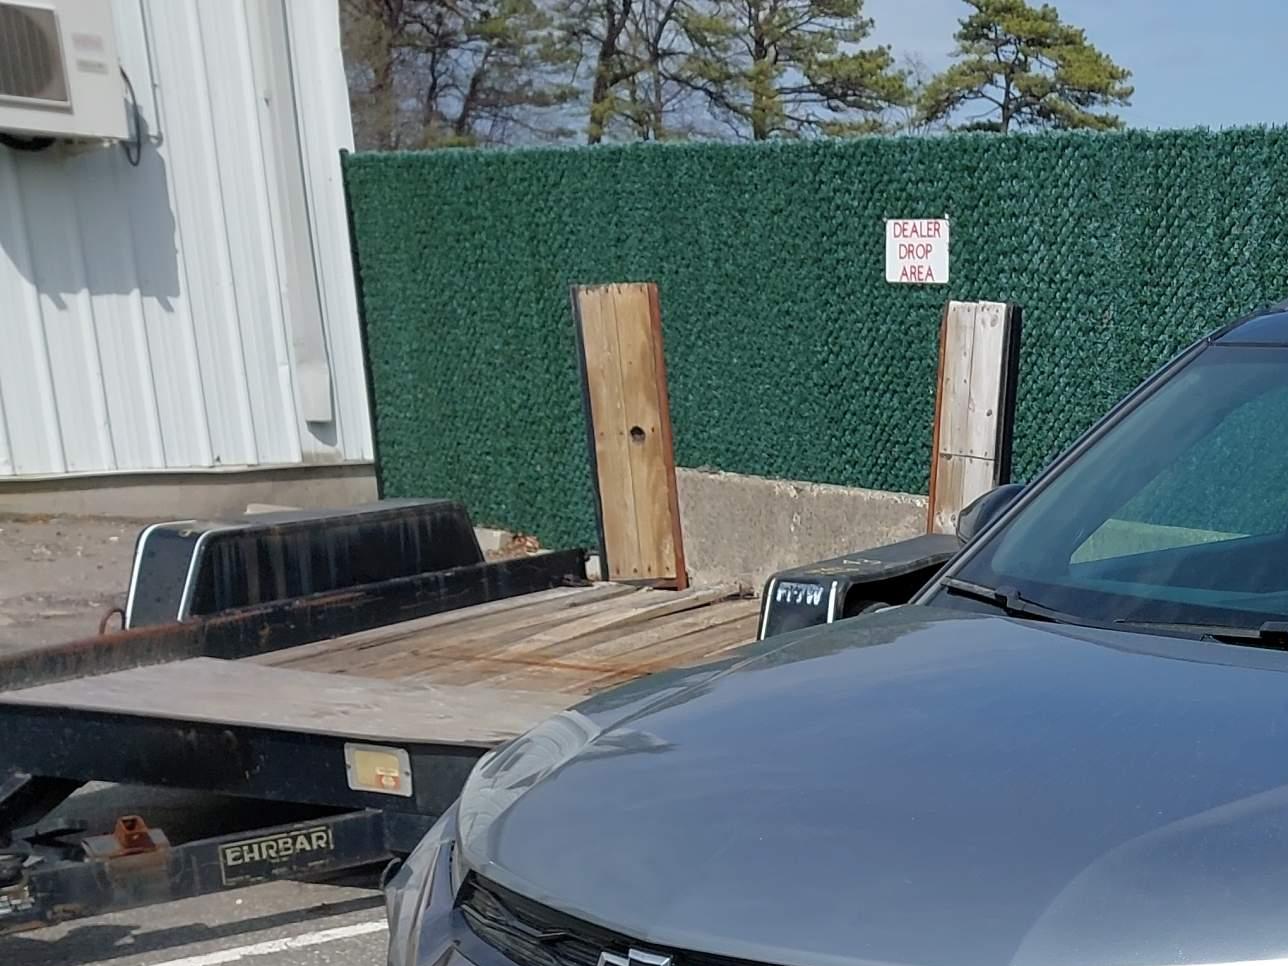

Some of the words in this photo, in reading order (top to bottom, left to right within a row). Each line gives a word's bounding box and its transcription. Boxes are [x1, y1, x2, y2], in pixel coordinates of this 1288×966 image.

[893, 221, 941, 239] DEALER
[898, 243, 933, 260] DROP
[900, 264, 935, 282] AREA
[225, 831, 328, 866] EHRBAR
